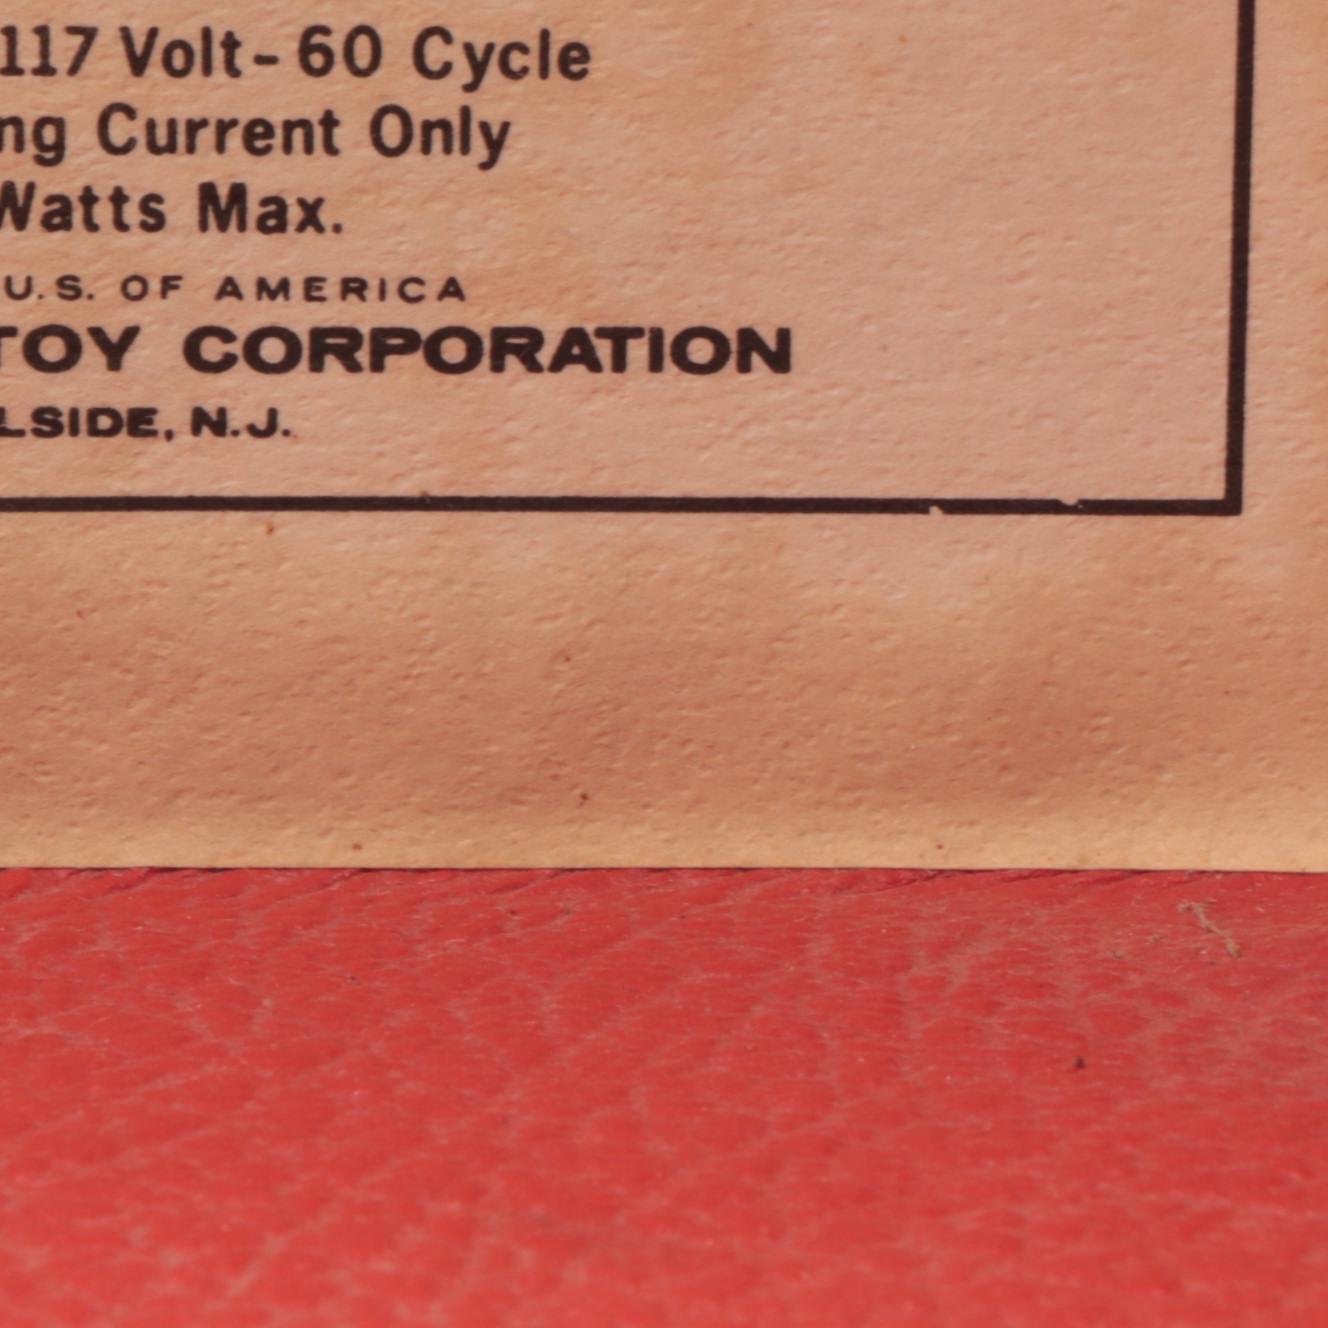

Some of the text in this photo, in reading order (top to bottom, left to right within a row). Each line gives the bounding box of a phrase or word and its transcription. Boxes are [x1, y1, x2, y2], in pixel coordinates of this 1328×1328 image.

[297, 24, 383, 79] 60
[412, 24, 592, 94] Cycle
[96, 102, 341, 158] Current
[369, 103, 512, 172] Only
[197, 181, 343, 236] Max.
[4, 274, 96, 302] U.S.
[120, 274, 185, 303] OF
[214, 274, 467, 306] AMERICA
[182, 324, 792, 376] CORPORATION
[190, 405, 292, 440] N.J.
